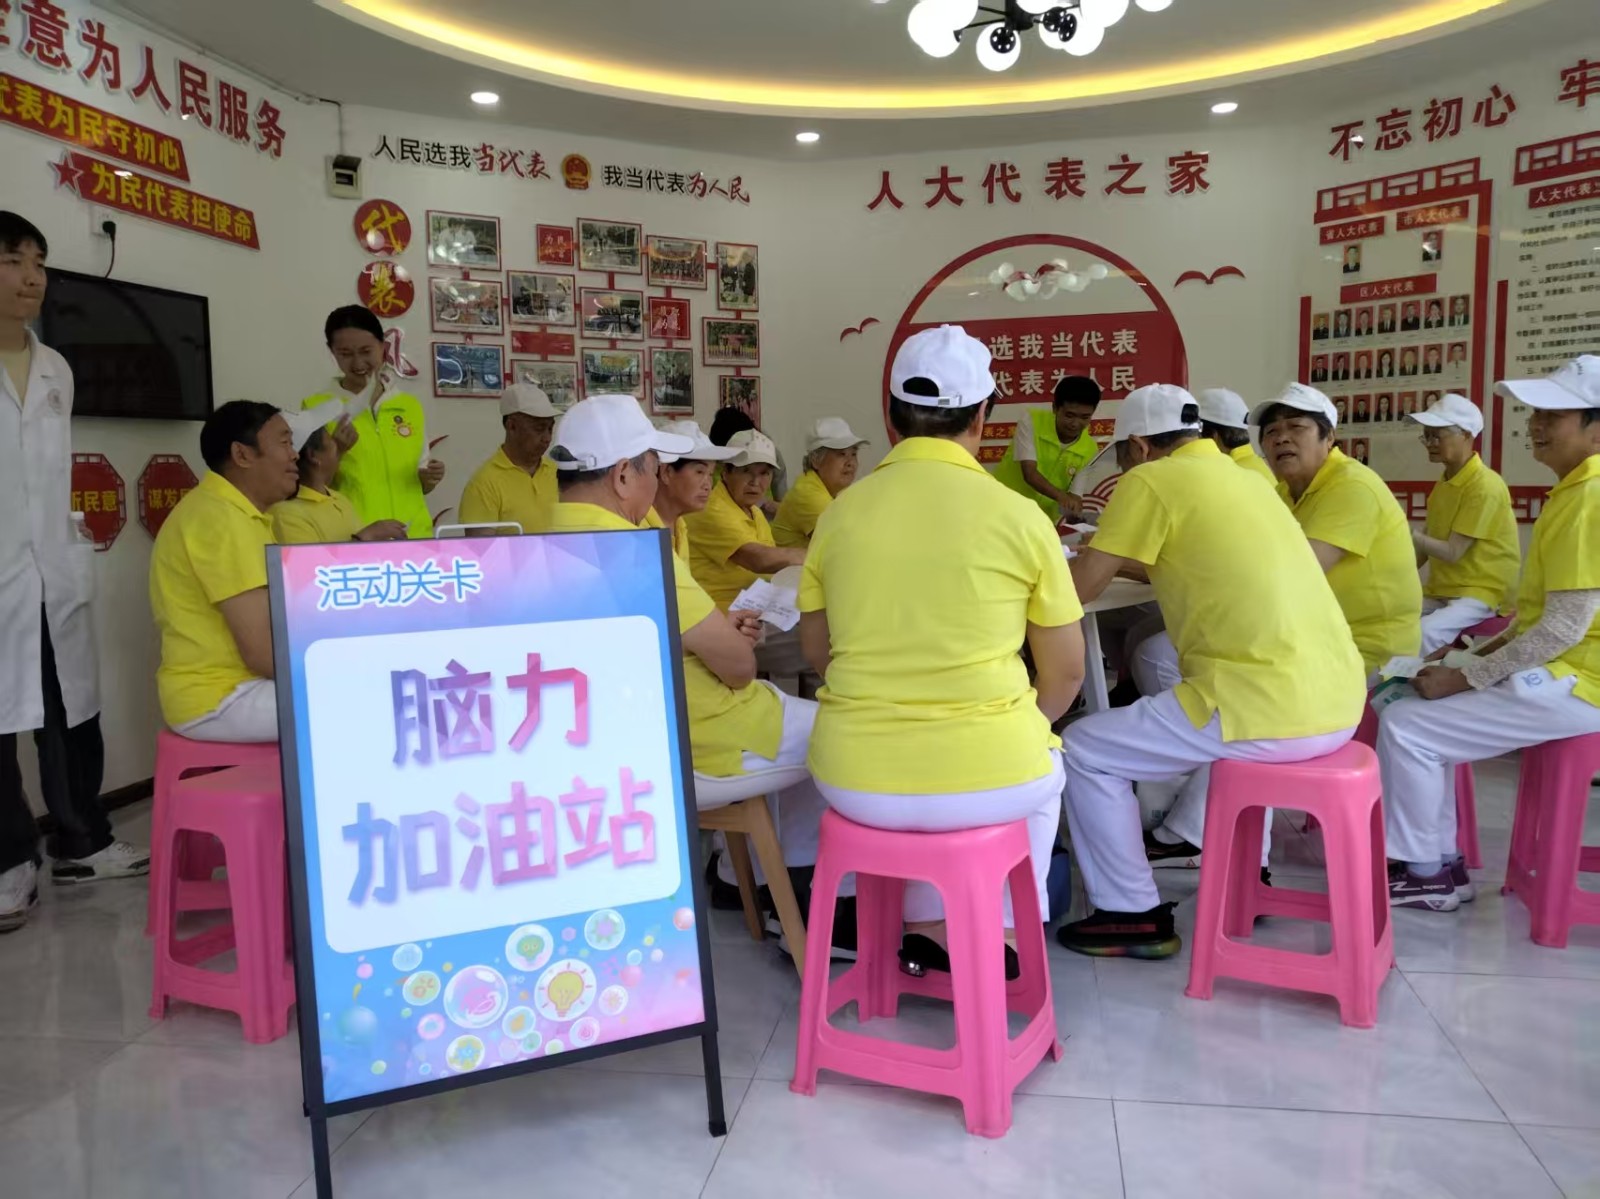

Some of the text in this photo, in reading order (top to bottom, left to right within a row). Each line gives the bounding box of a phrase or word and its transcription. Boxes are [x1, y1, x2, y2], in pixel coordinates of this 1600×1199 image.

[0, 0, 286, 158] 意为人民服务
[1329, 59, 1600, 161] 不忘初心 牢
[374, 135, 551, 179] 人民选我当代表
[92, 163, 253, 241] 为民代表担使命
[604, 165, 750, 202] 我当代表为人民
[867, 151, 1210, 211] 人大代表之家
[1325, 222, 1378, 240] 省人大代表
[1403, 205, 1462, 225] 市人大代表
[1360, 281, 1414, 297] 区人大代表
[977, 329, 1138, 360] 选我当代表
[149, 488, 192, 509] 谋发
[316, 558, 482, 609] 活动关卡
[390, 652, 590, 768] 脑力
[341, 766, 656, 905] 加油站
